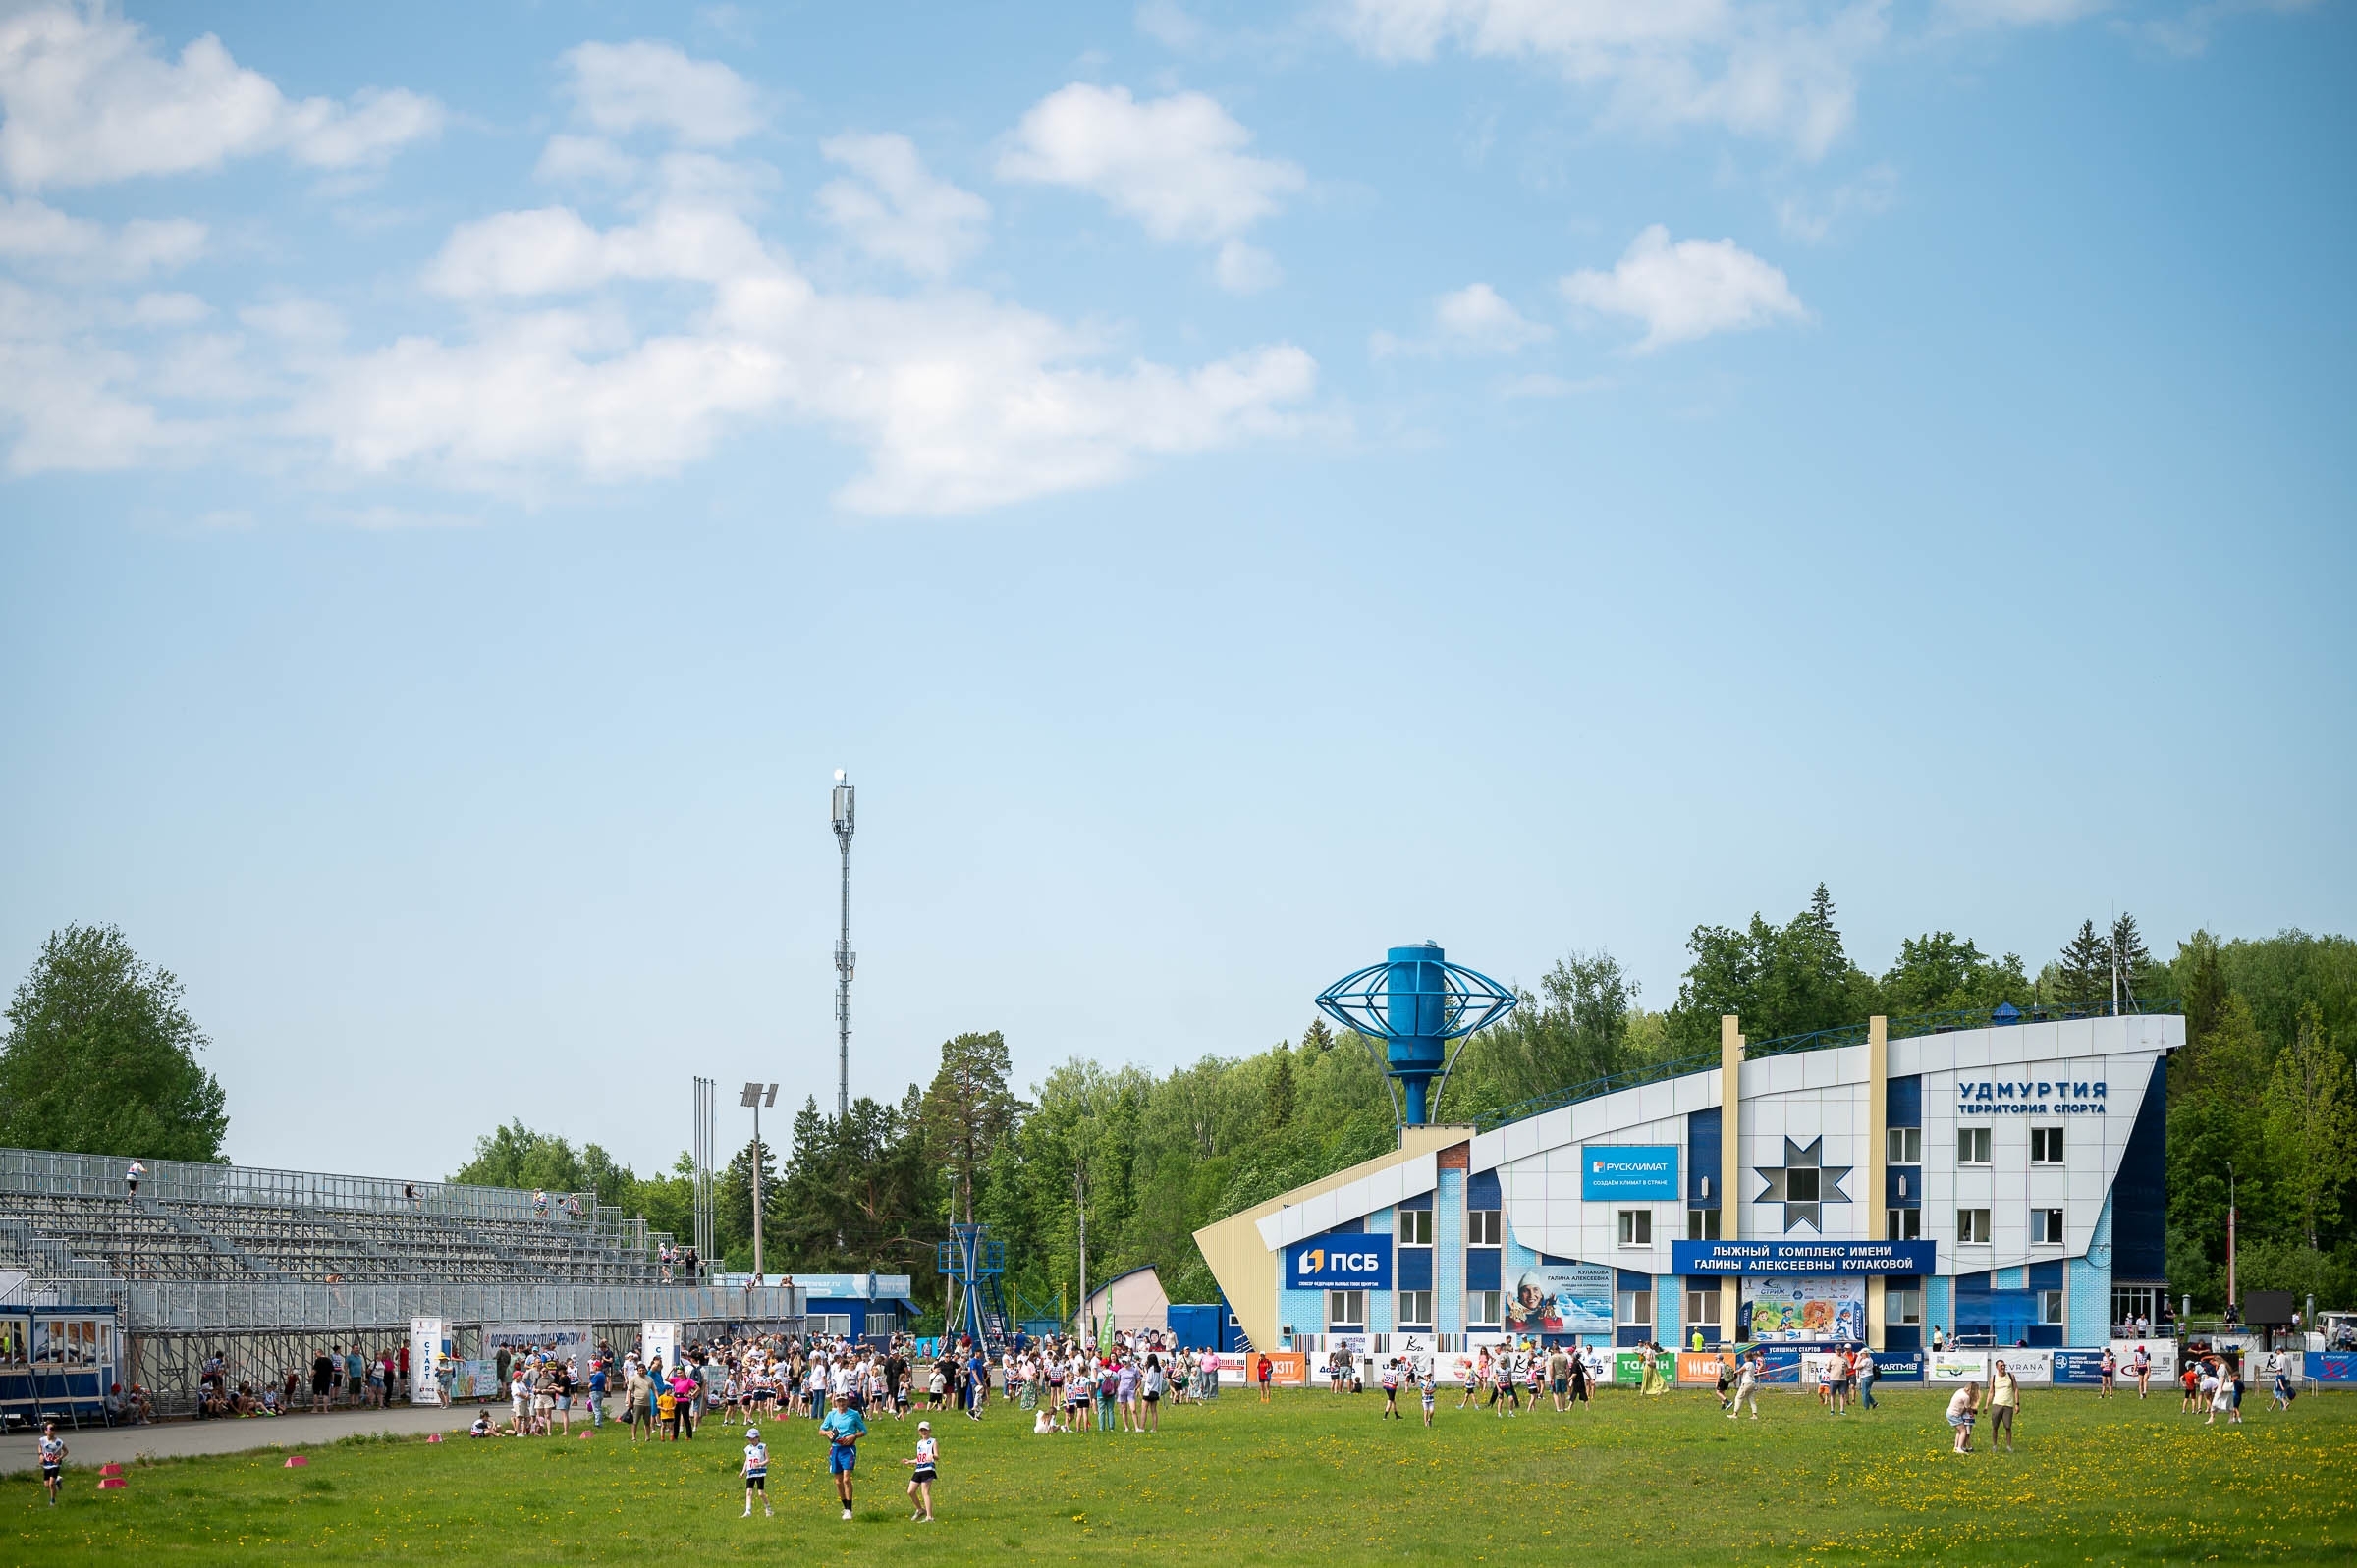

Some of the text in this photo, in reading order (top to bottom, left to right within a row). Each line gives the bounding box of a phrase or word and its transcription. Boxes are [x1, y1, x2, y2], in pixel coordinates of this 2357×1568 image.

[1958, 1082, 2107, 1101] УДМУРТИЯ
[1958, 1104, 2106, 1114] ТЕРРИТОРИЯ СПОРТА
[1607, 1162, 1668, 1171] РУСКЛИМАТ
[1713, 1245, 1892, 1257] ЛЫЖНЫЙ КОМПЛЕКС ИМЕНИ
[1331, 1253, 1379, 1271] ПСБ
[1694, 1257, 1913, 1271] ГАЛИНЫ АЛЕКСЕЕВНЫ КУЛАКОВОЙ
[1622, 1360, 1669, 1371] тан
[1702, 1362, 1720, 1375] ИЗТ
